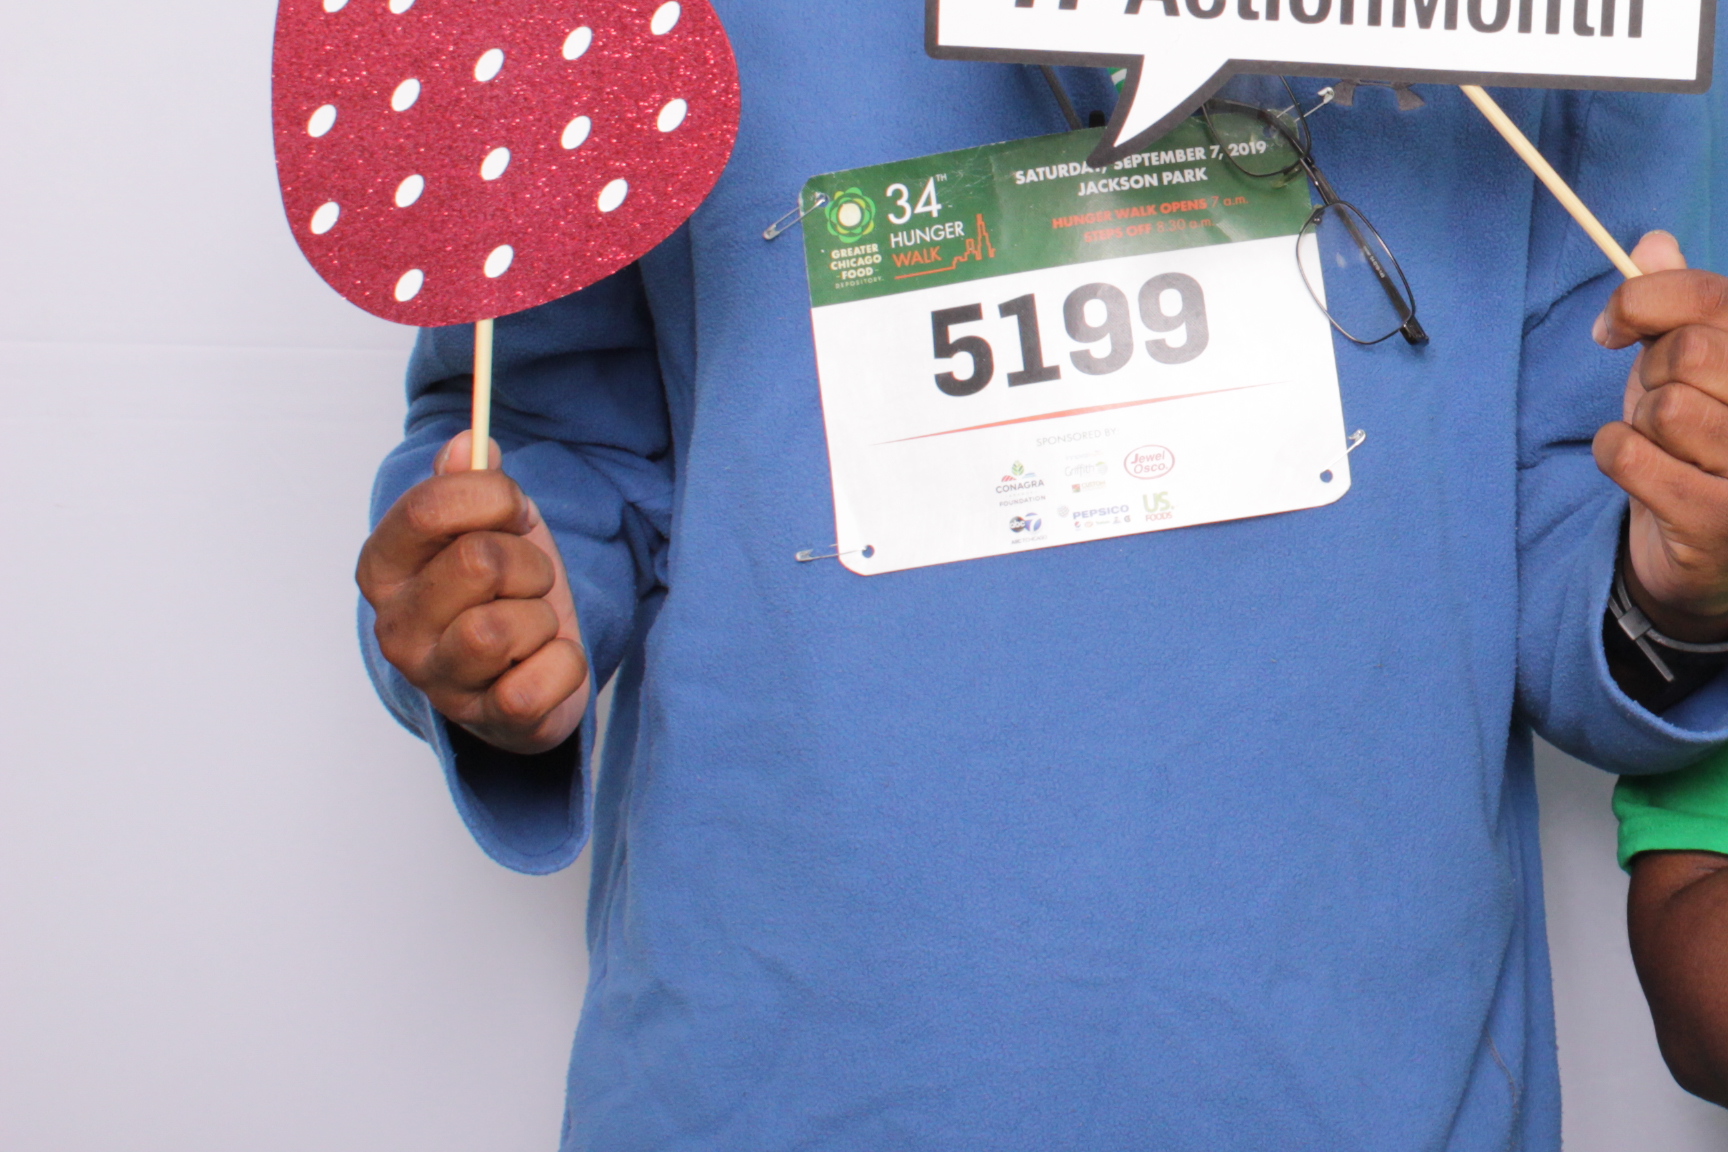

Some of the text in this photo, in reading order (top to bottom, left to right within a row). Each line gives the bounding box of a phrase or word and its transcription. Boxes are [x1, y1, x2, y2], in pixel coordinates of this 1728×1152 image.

[1015, 140, 1267, 185] SATURDA, SEPTEMBER 7, 2019
[1077, 167, 1208, 197] JACKSON PARK
[1052, 211, 1113, 229] HUNGER
[1114, 204, 1158, 219] WALK
[1160, 196, 1208, 215] OPENS
[890, 221, 965, 248] HUNGER
[1083, 225, 1123, 244] STEPS
[1126, 222, 1152, 237] OFF
[830, 243, 879, 259] GREATER
[892, 246, 942, 267] WALK
[830, 254, 882, 271] CHICAGO
[930, 272, 1210, 398] 5199
[1036, 429, 1102, 447] SPONSORED
[1131, 451, 1166, 465] Jewel
[995, 479, 1045, 494] CONAGRA
[999, 495, 1046, 507] FOUNDATION
[1072, 505, 1130, 520] PEPSICO
[1145, 511, 1173, 522] FOODS
[1010, 519, 1025, 528] abc
